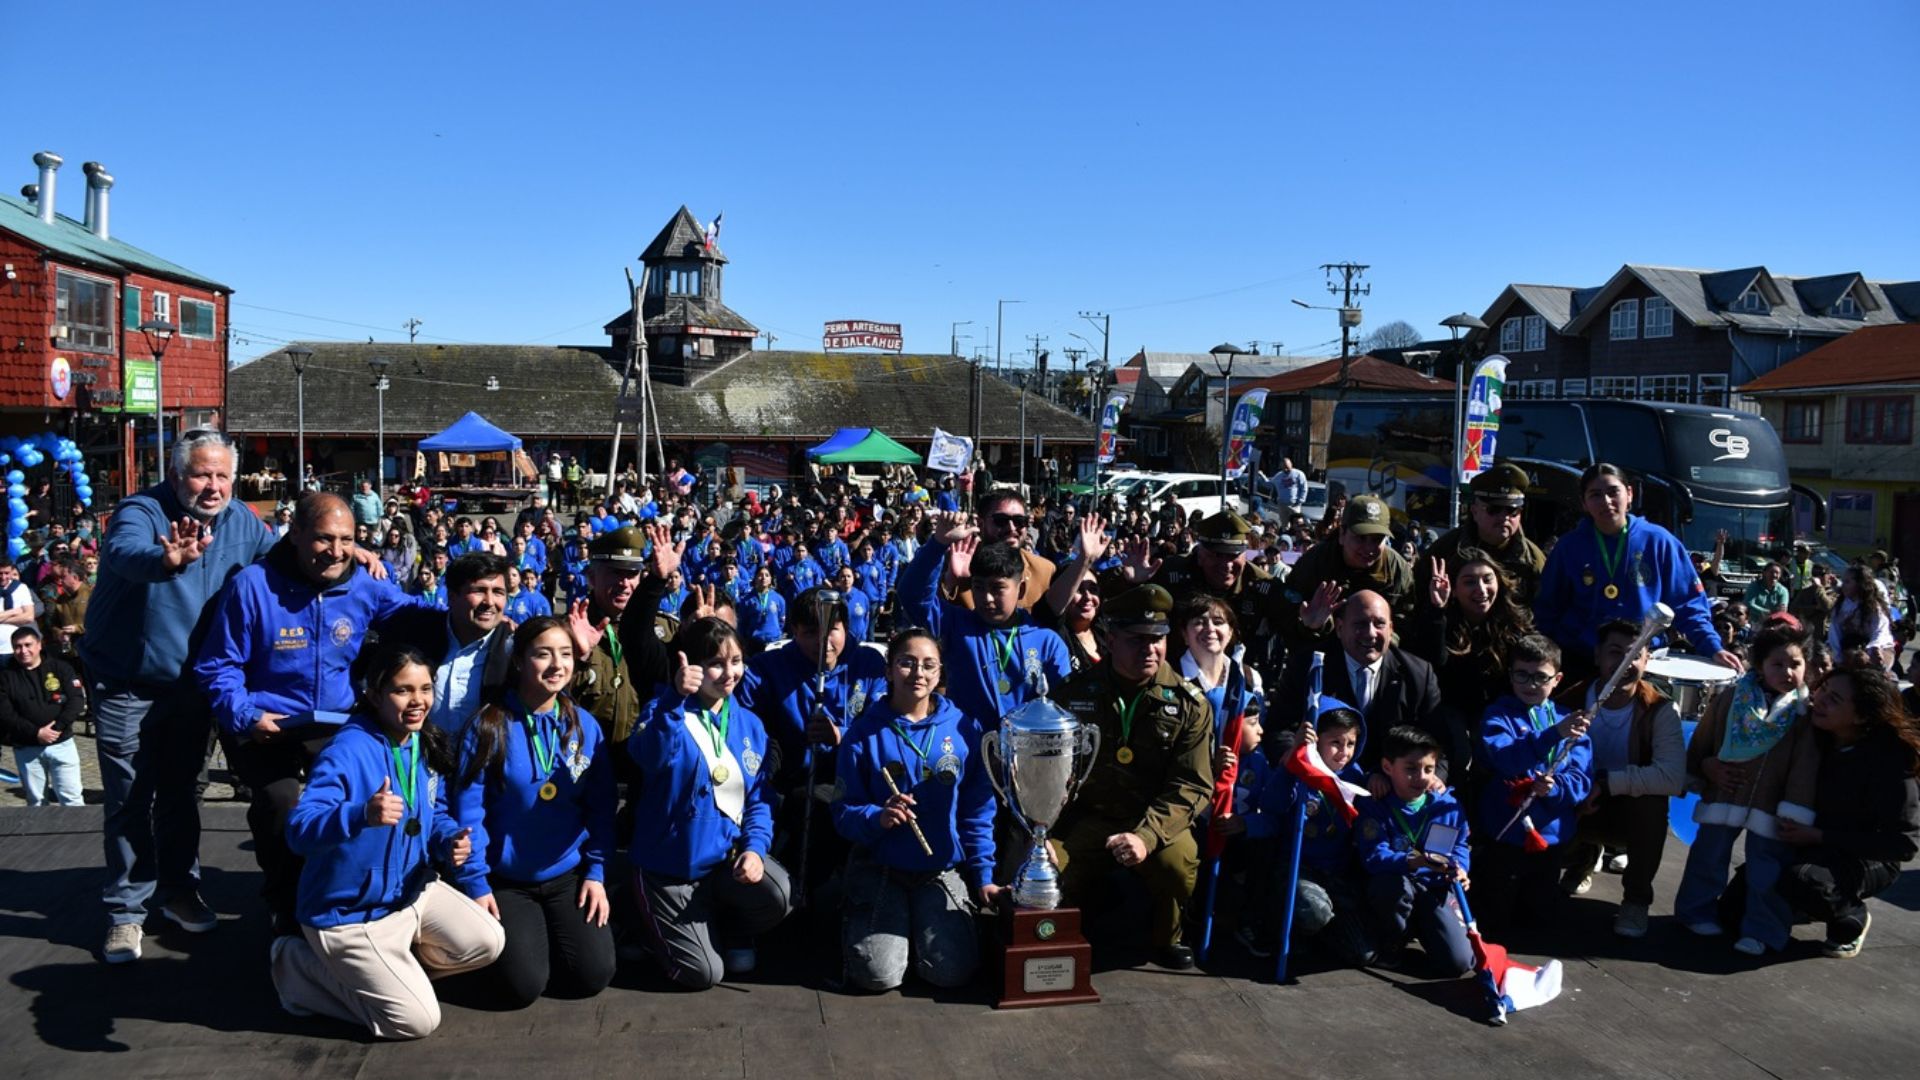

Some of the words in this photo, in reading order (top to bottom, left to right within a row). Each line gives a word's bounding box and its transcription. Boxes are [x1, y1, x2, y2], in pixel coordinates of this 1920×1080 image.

[825, 322, 850, 333] FERIA
[852, 322, 899, 334] ARTESANAL
[824, 337, 840, 347] DE
[842, 335, 902, 349] DALCAHUE
